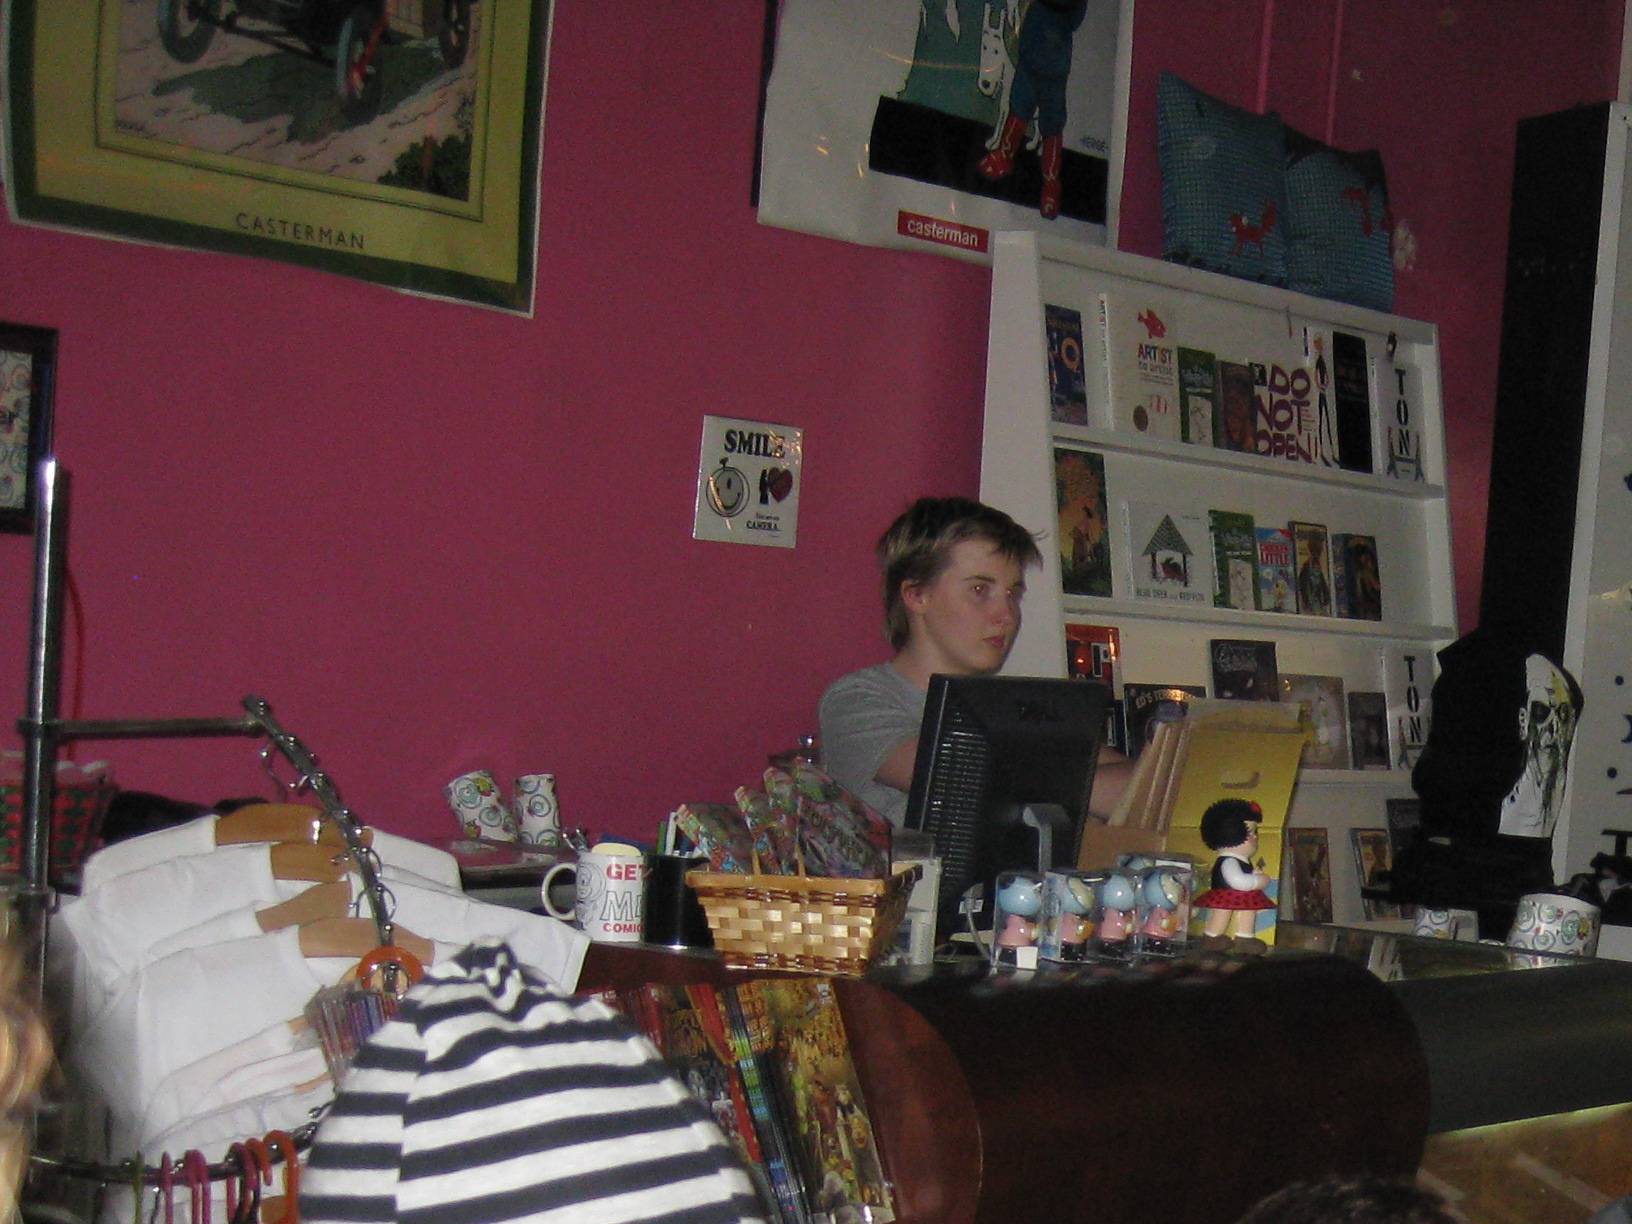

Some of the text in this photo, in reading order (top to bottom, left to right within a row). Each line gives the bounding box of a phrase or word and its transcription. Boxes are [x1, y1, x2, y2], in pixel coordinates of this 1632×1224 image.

[235, 211, 365, 249] CASTERMAN
[906, 217, 980, 249] casterman
[1137, 342, 1174, 365] ARTIST
[1268, 363, 1311, 399] DO
[1256, 394, 1311, 435] NOT
[723, 428, 786, 459] SMILE
